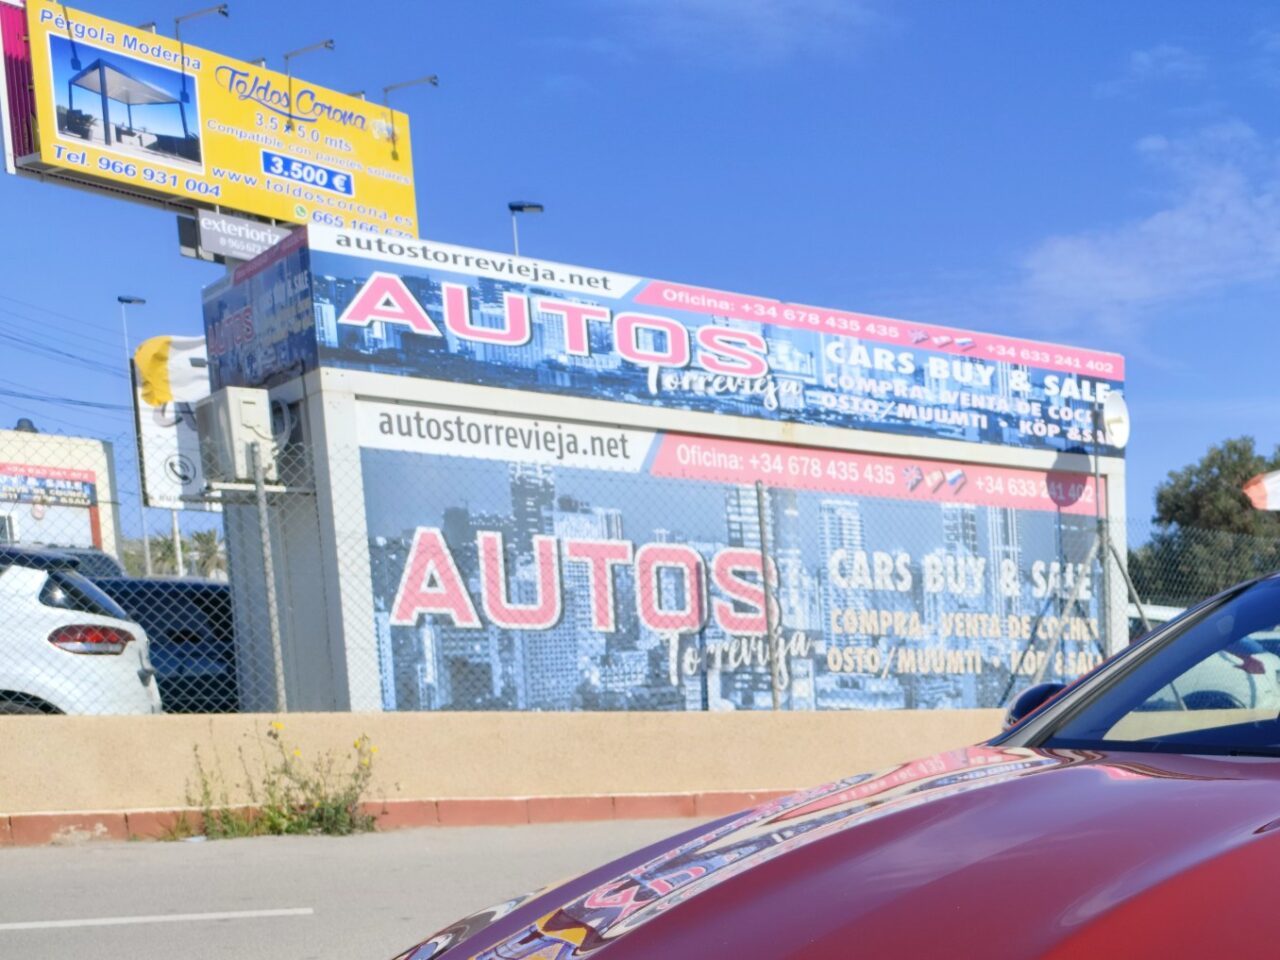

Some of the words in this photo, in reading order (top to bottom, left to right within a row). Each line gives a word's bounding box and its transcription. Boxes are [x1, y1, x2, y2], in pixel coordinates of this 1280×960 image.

[40, 9, 116, 44] Pérgola
[122, 34, 201, 70] Moderna
[214, 65, 291, 108] Toldos
[296, 89, 367, 131] Corona
[53, 144, 91, 166] Tel.
[98, 157, 137, 178] 966
[143, 168, 178, 187] 931
[185, 178, 221, 197] 004
[207, 119, 284, 148] Compatible
[288, 144, 313, 155] con
[315, 148, 363, 170] paneles
[367, 166, 411, 184] solares
[270, 156, 328, 186] 3.500
[332, 173, 348, 192] €
[312, 210, 344, 228] 665
[335, 232, 612, 291] autostorrevieja.net
[337, 271, 769, 377] AUTOS
[663, 288, 735, 312] Oficina:
[740, 303, 778, 319] +34
[783, 309, 821, 326] 678
[825, 315, 861, 332] 435
[865, 322, 899, 338] 435
[825, 340, 916, 375] CARS
[928, 356, 997, 386] BUY
[1010, 370, 1032, 393] &
[1043, 374, 1111, 404] SALE
[985, 343, 1016, 358] +34
[1019, 347, 1050, 364] 633
[1054, 352, 1082, 368] 241
[1085, 357, 1115, 374] 402
[648, 363, 802, 411] Torrevieja
[824, 372, 924, 401] COMPRA
[944, 390, 1010, 413] VENTA
[1017, 399, 1042, 417] DE
[378, 408, 631, 460] autostorrevieja.net
[1019, 417, 1061, 438] KÖP
[676, 443, 744, 470] Oficina:
[749, 452, 784, 474] +34
[787, 455, 823, 478] 678
[826, 459, 860, 482] 435
[863, 463, 896, 485] 435
[975, 474, 1004, 495] +34
[1007, 477, 1037, 497] 633
[1040, 480, 1065, 501] 241
[1068, 482, 1093, 504] 402
[390, 525, 779, 636] AUTOS
[827, 549, 913, 592] CARS
[921, 552, 987, 597] BUY
[1000, 558, 1020, 598] &
[1031, 559, 1092, 600] SALE
[831, 608, 923, 638] COMPRA
[941, 612, 1002, 639] VENTA
[1007, 613, 1031, 640] DE
